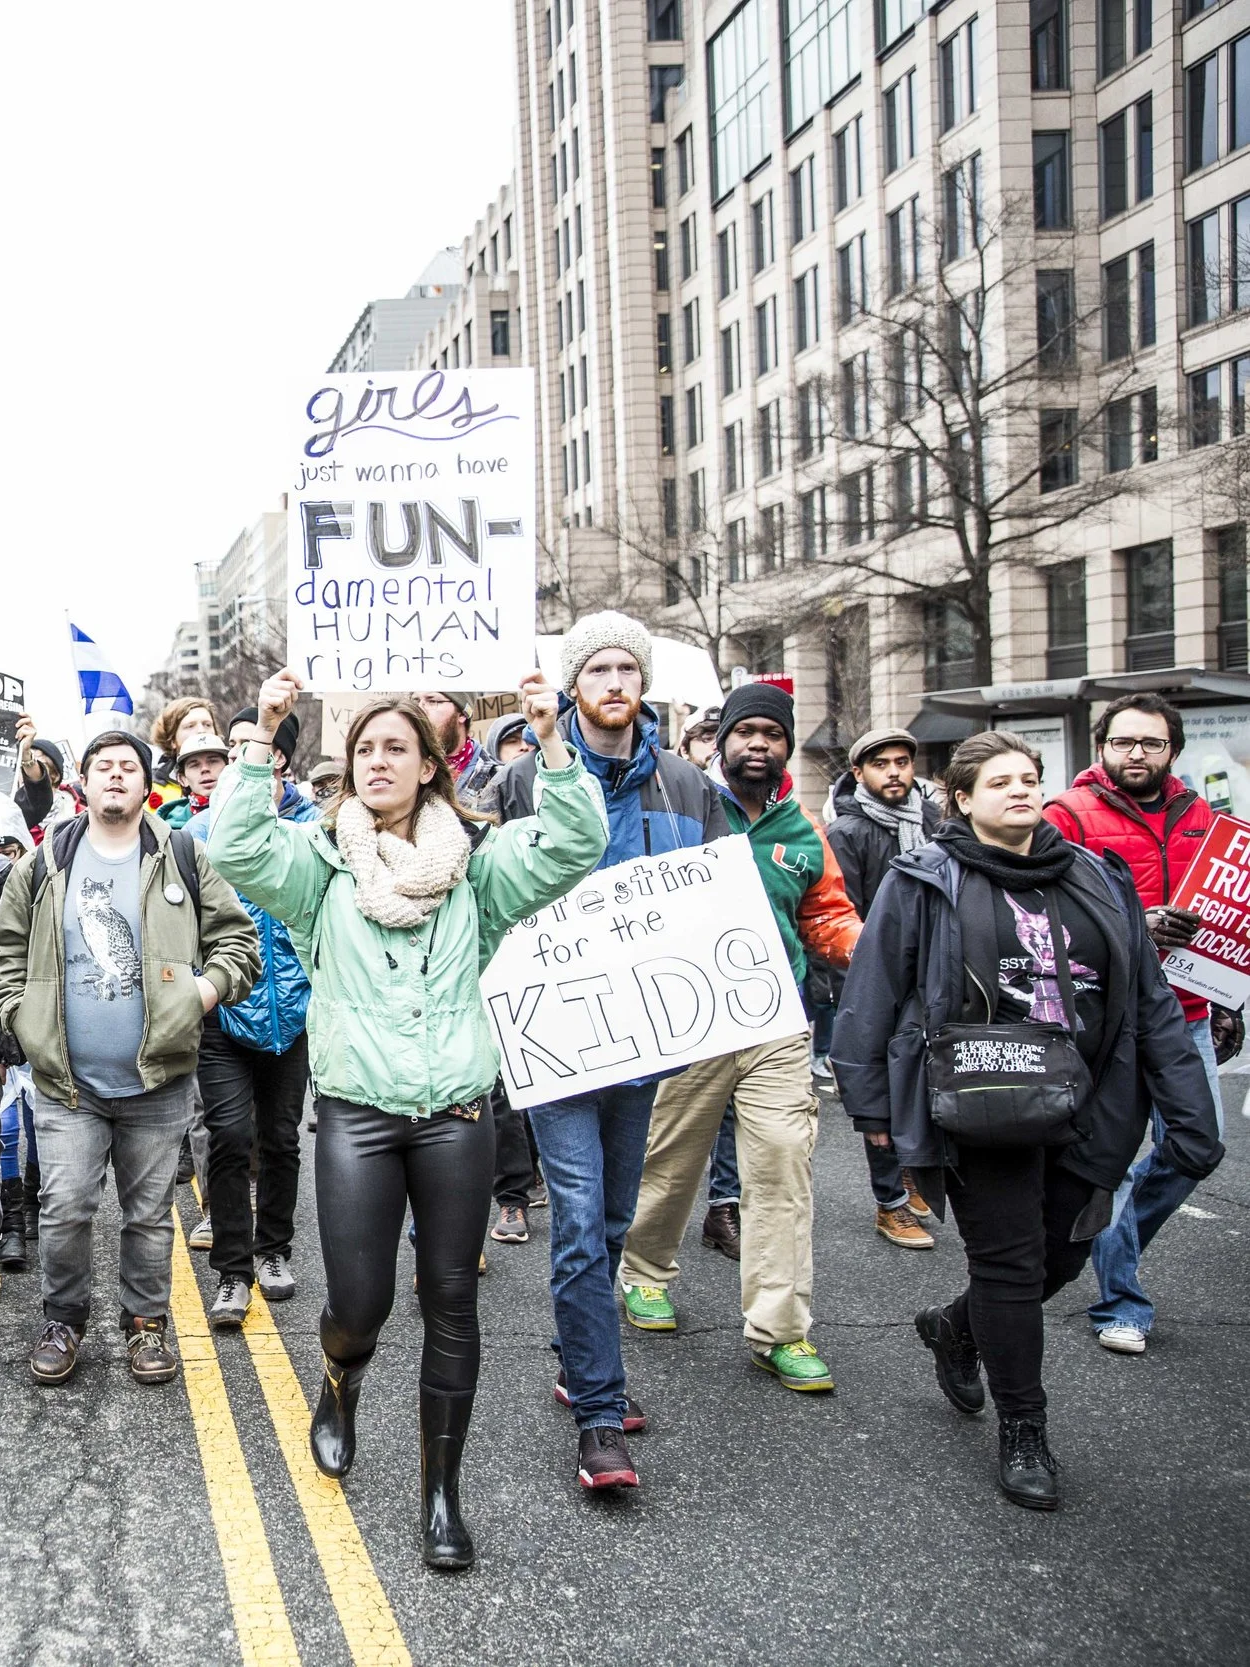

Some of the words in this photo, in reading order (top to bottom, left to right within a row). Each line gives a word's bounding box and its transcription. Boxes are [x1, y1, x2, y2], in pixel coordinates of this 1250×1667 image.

[304, 370, 499, 457] girls
[294, 460, 344, 491] just
[355, 460, 440, 483] wanna
[457, 453, 509, 476] have
[300, 496, 524, 570] FUN-
[295, 568, 492, 609] damental
[313, 607, 499, 641] HUMAN
[306, 648, 464, 690] rights
[1187, 892, 1242, 930] FIGHT
[533, 933, 588, 967] for
[610, 910, 665, 943] the
[999, 958, 1029, 970] SSY
[1167, 955, 1194, 972] DSA
[487, 927, 782, 1090] KIDS
[1001, 1065, 1046, 1073] ADDRESSES
